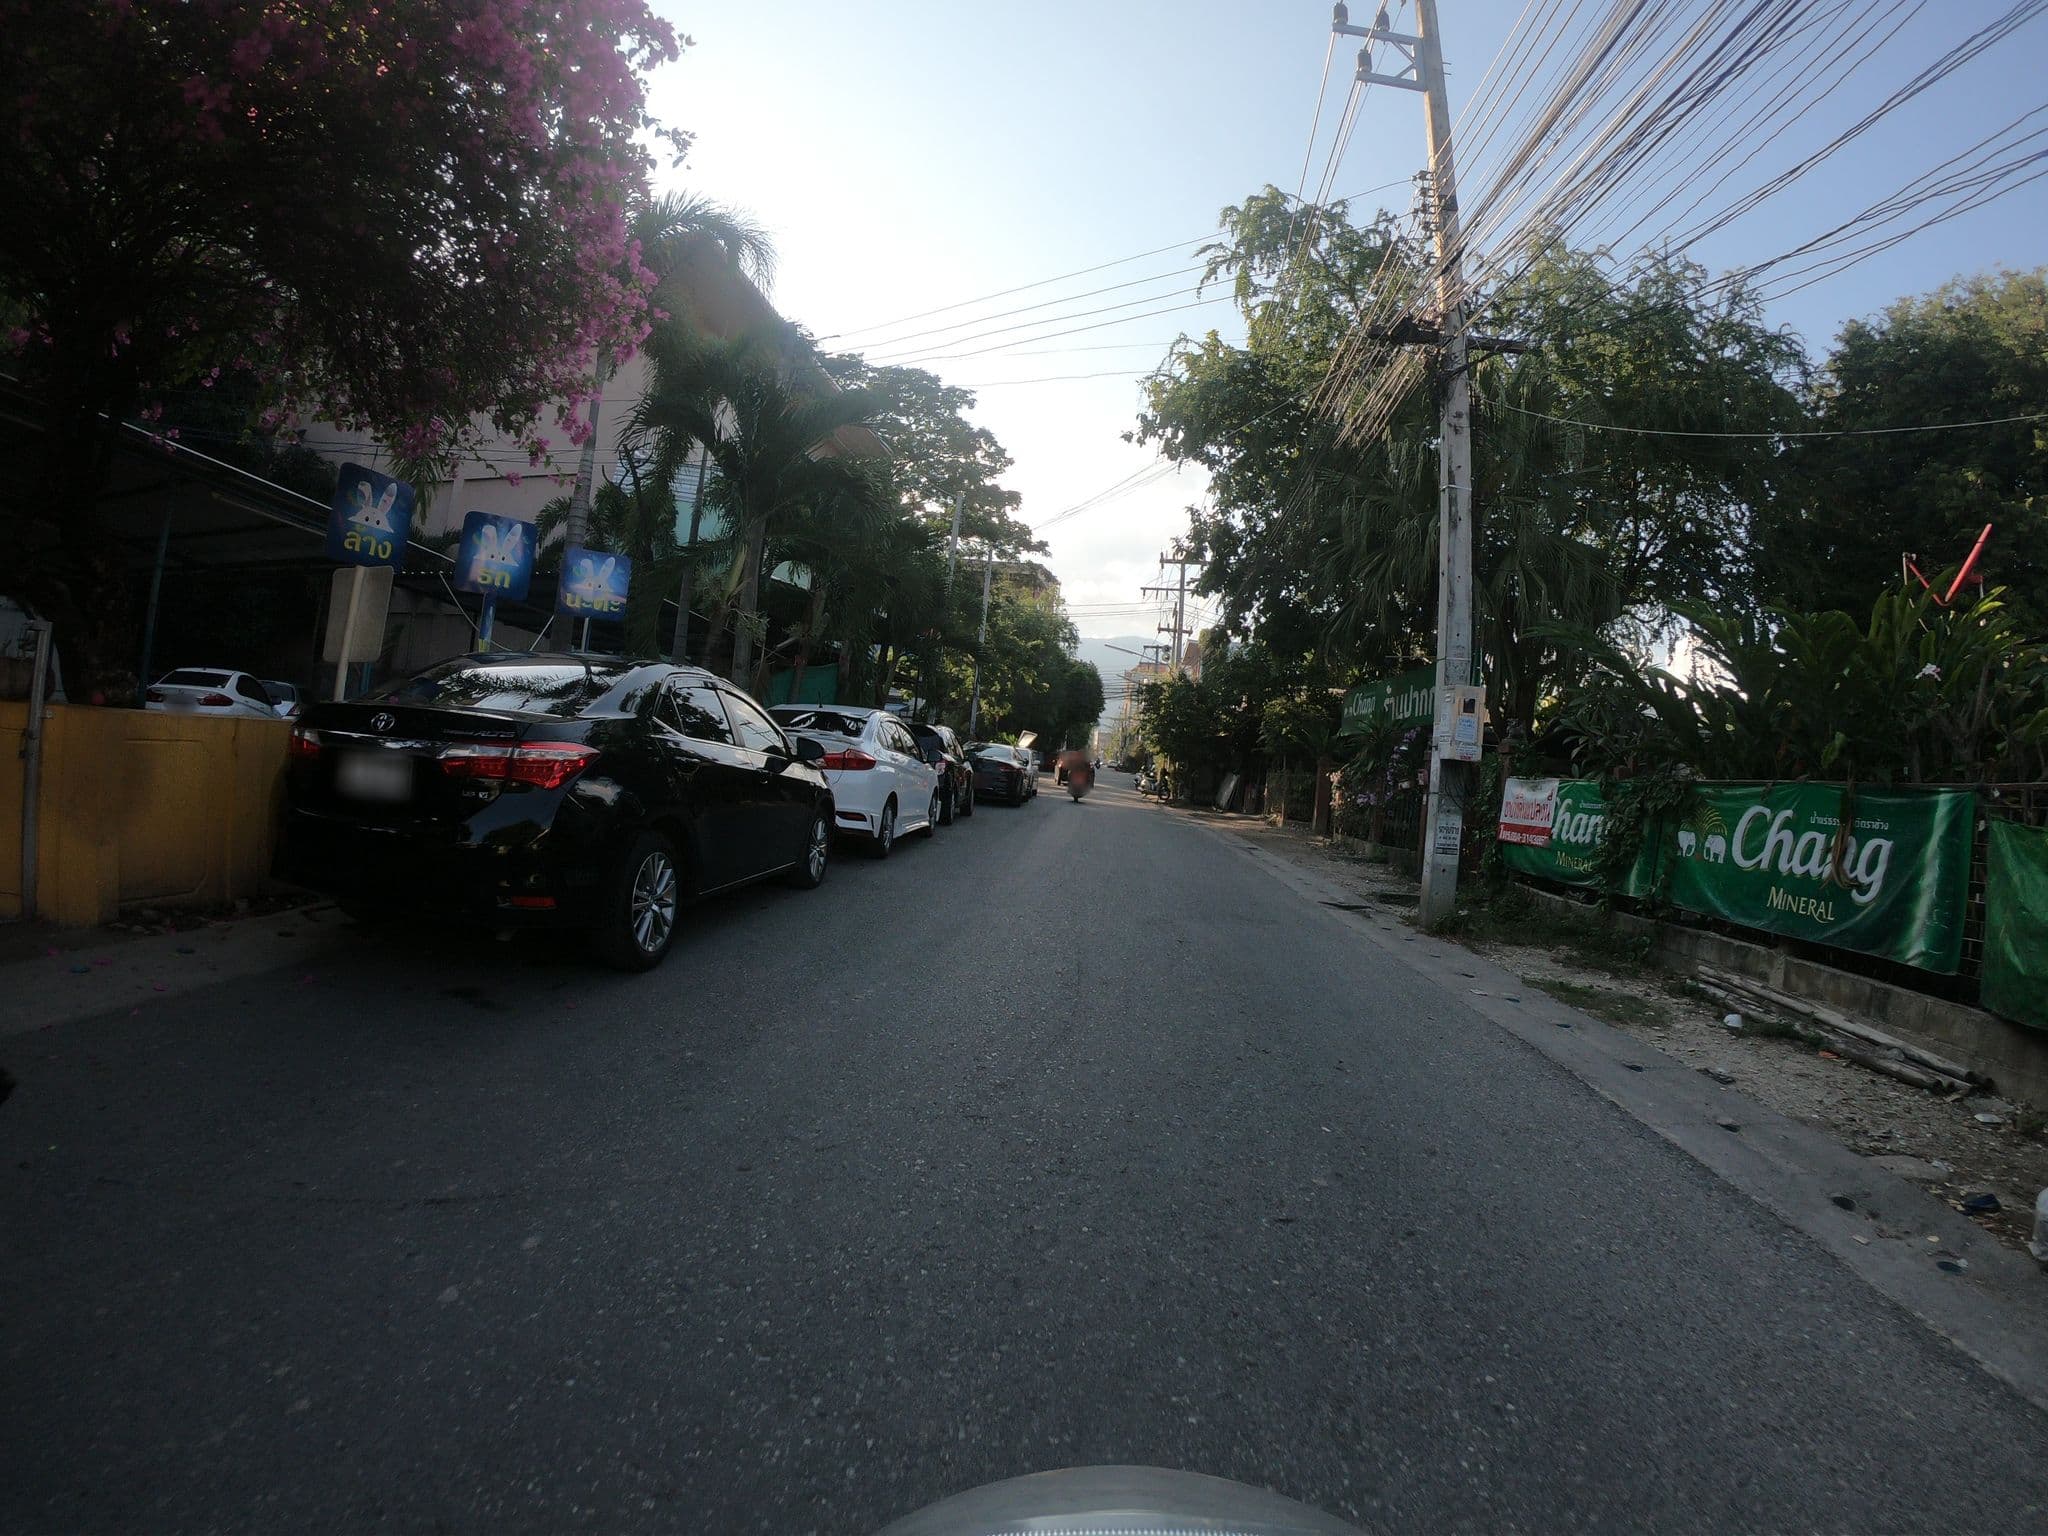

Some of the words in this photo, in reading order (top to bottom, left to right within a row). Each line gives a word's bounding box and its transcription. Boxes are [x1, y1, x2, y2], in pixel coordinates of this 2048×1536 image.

[343, 524, 392, 559] ล้าง
[1731, 804, 1895, 905] Chang
[1767, 886, 1837, 924] MINERAL
